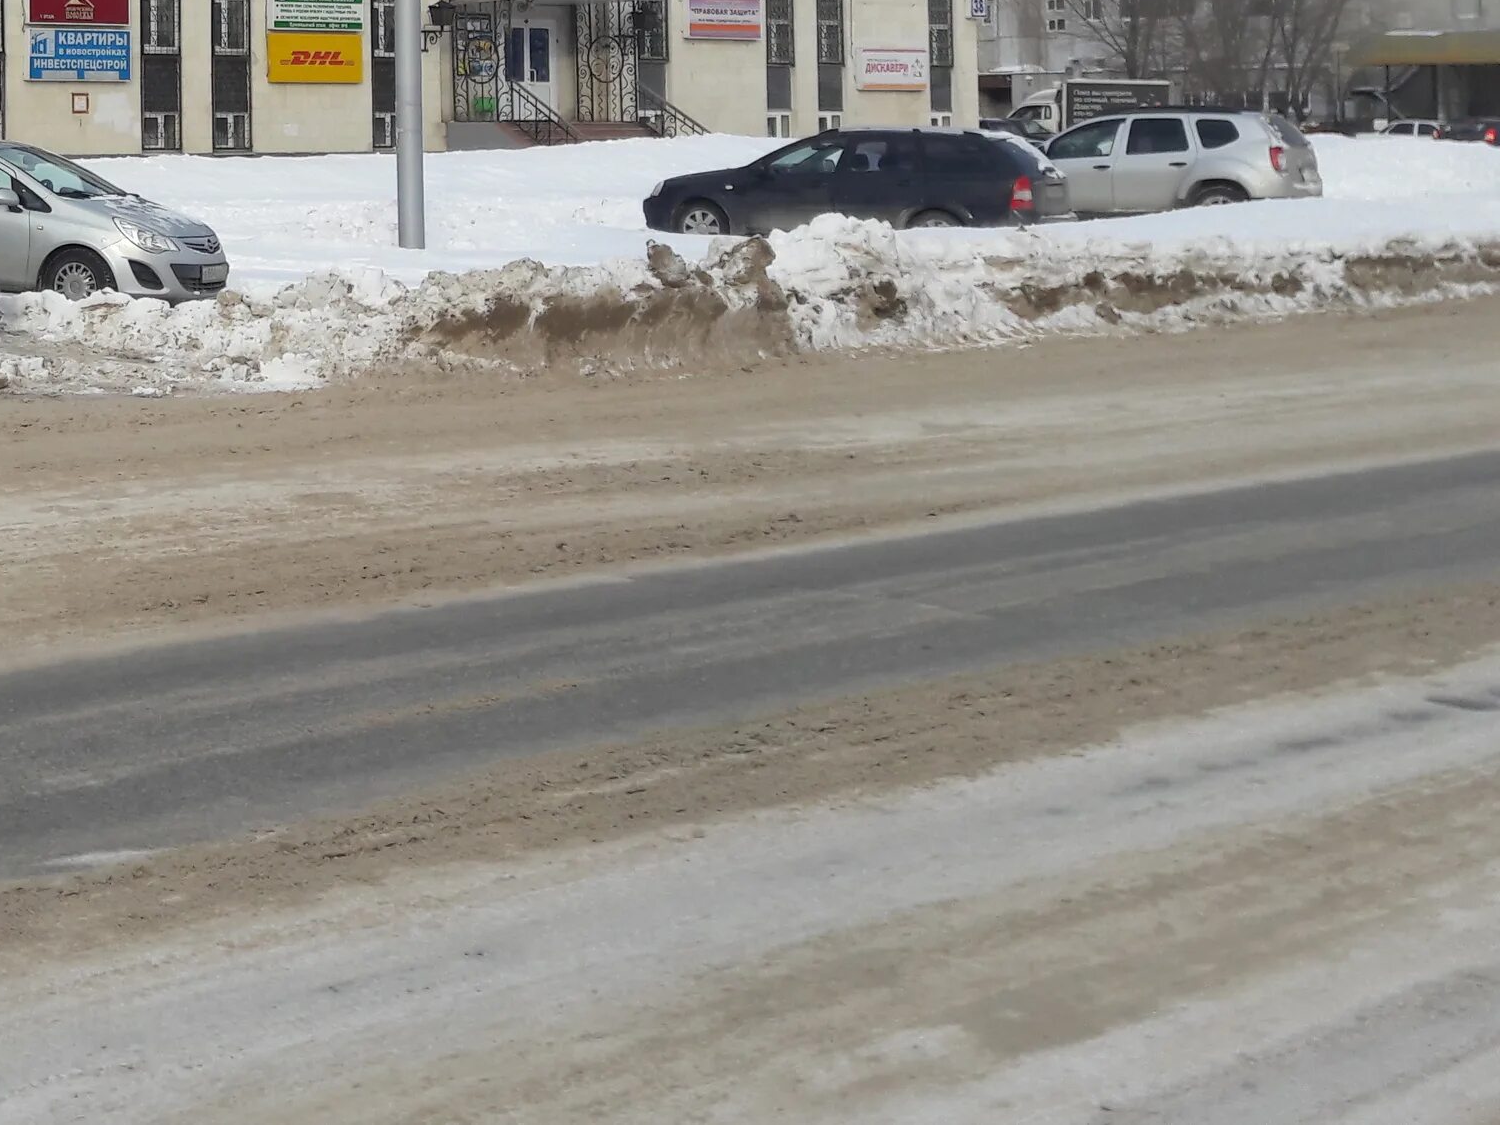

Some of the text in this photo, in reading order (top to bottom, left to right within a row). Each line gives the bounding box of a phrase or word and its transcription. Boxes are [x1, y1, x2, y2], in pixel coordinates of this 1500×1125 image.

[691, 7, 728, 16] "ПРАВОВАЯ
[58, 32, 128, 46] КВАРТИРЫ
[66, 47, 128, 58] новостройках
[290, 51, 345, 66] DHL
[33, 57, 128, 71] ИНВЕСТСПЕЦСТРОЙ
[865, 63, 909, 74] ДИСКАВЕРИ
